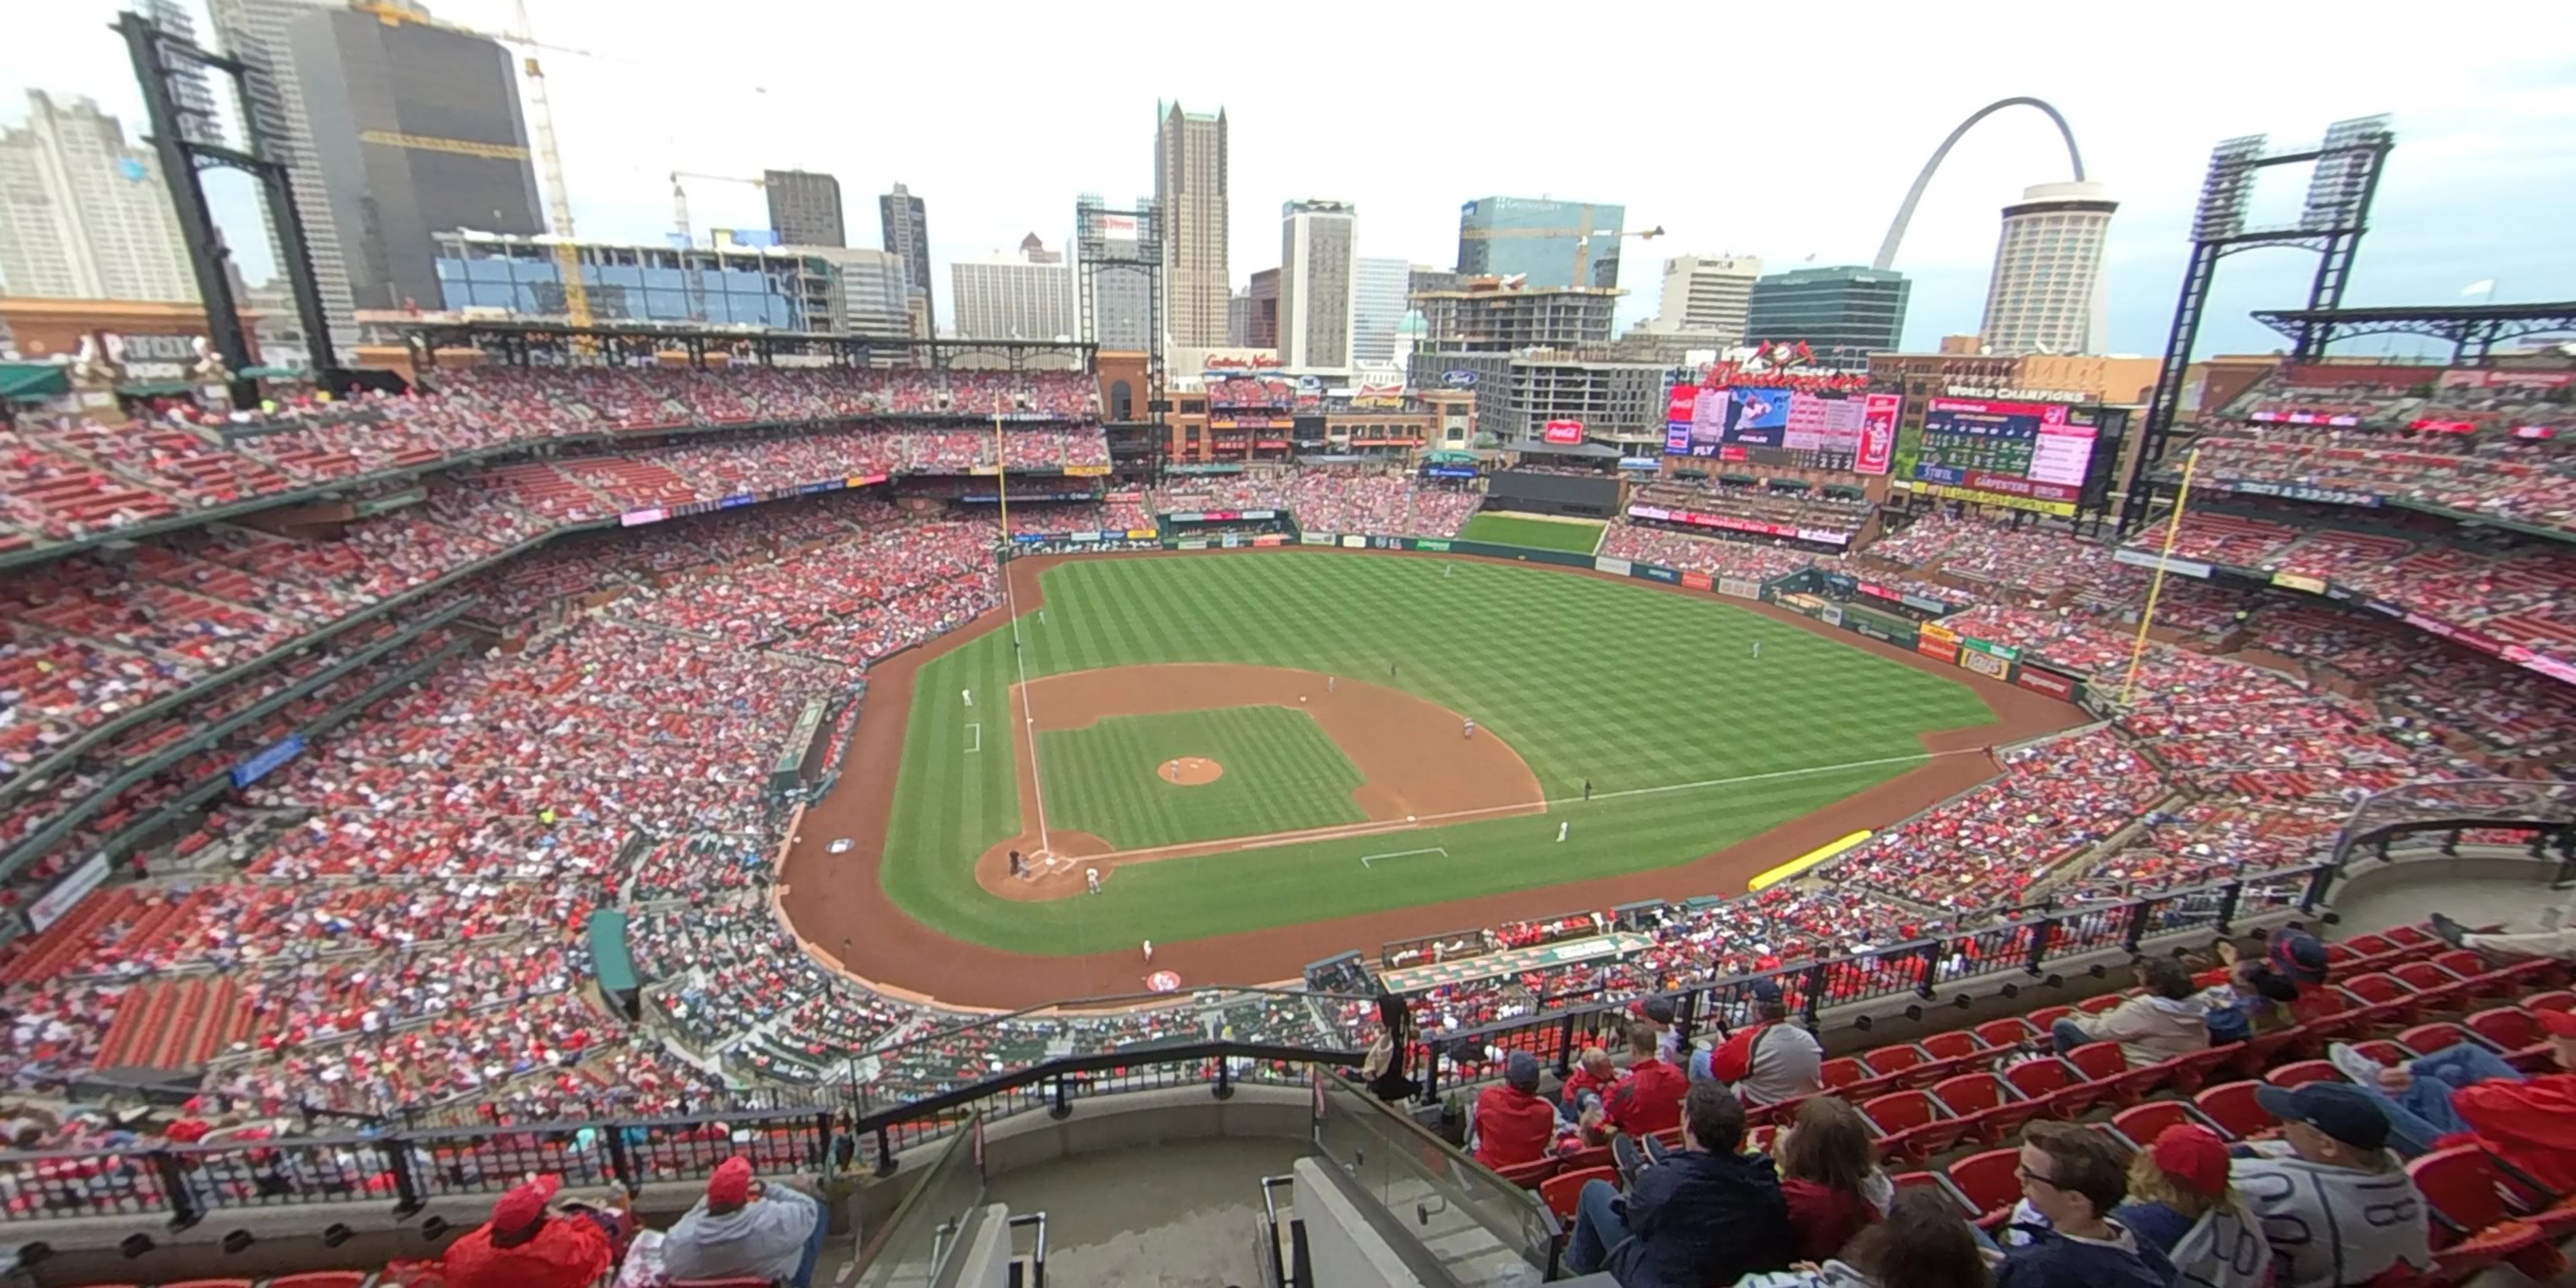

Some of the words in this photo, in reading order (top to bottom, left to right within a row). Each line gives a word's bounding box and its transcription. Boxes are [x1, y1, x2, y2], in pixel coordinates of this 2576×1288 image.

[1946, 385, 1995, 399] WORLD
[1996, 386, 2086, 402] CHAMPIONS
[1692, 444, 1716, 457] FLY
